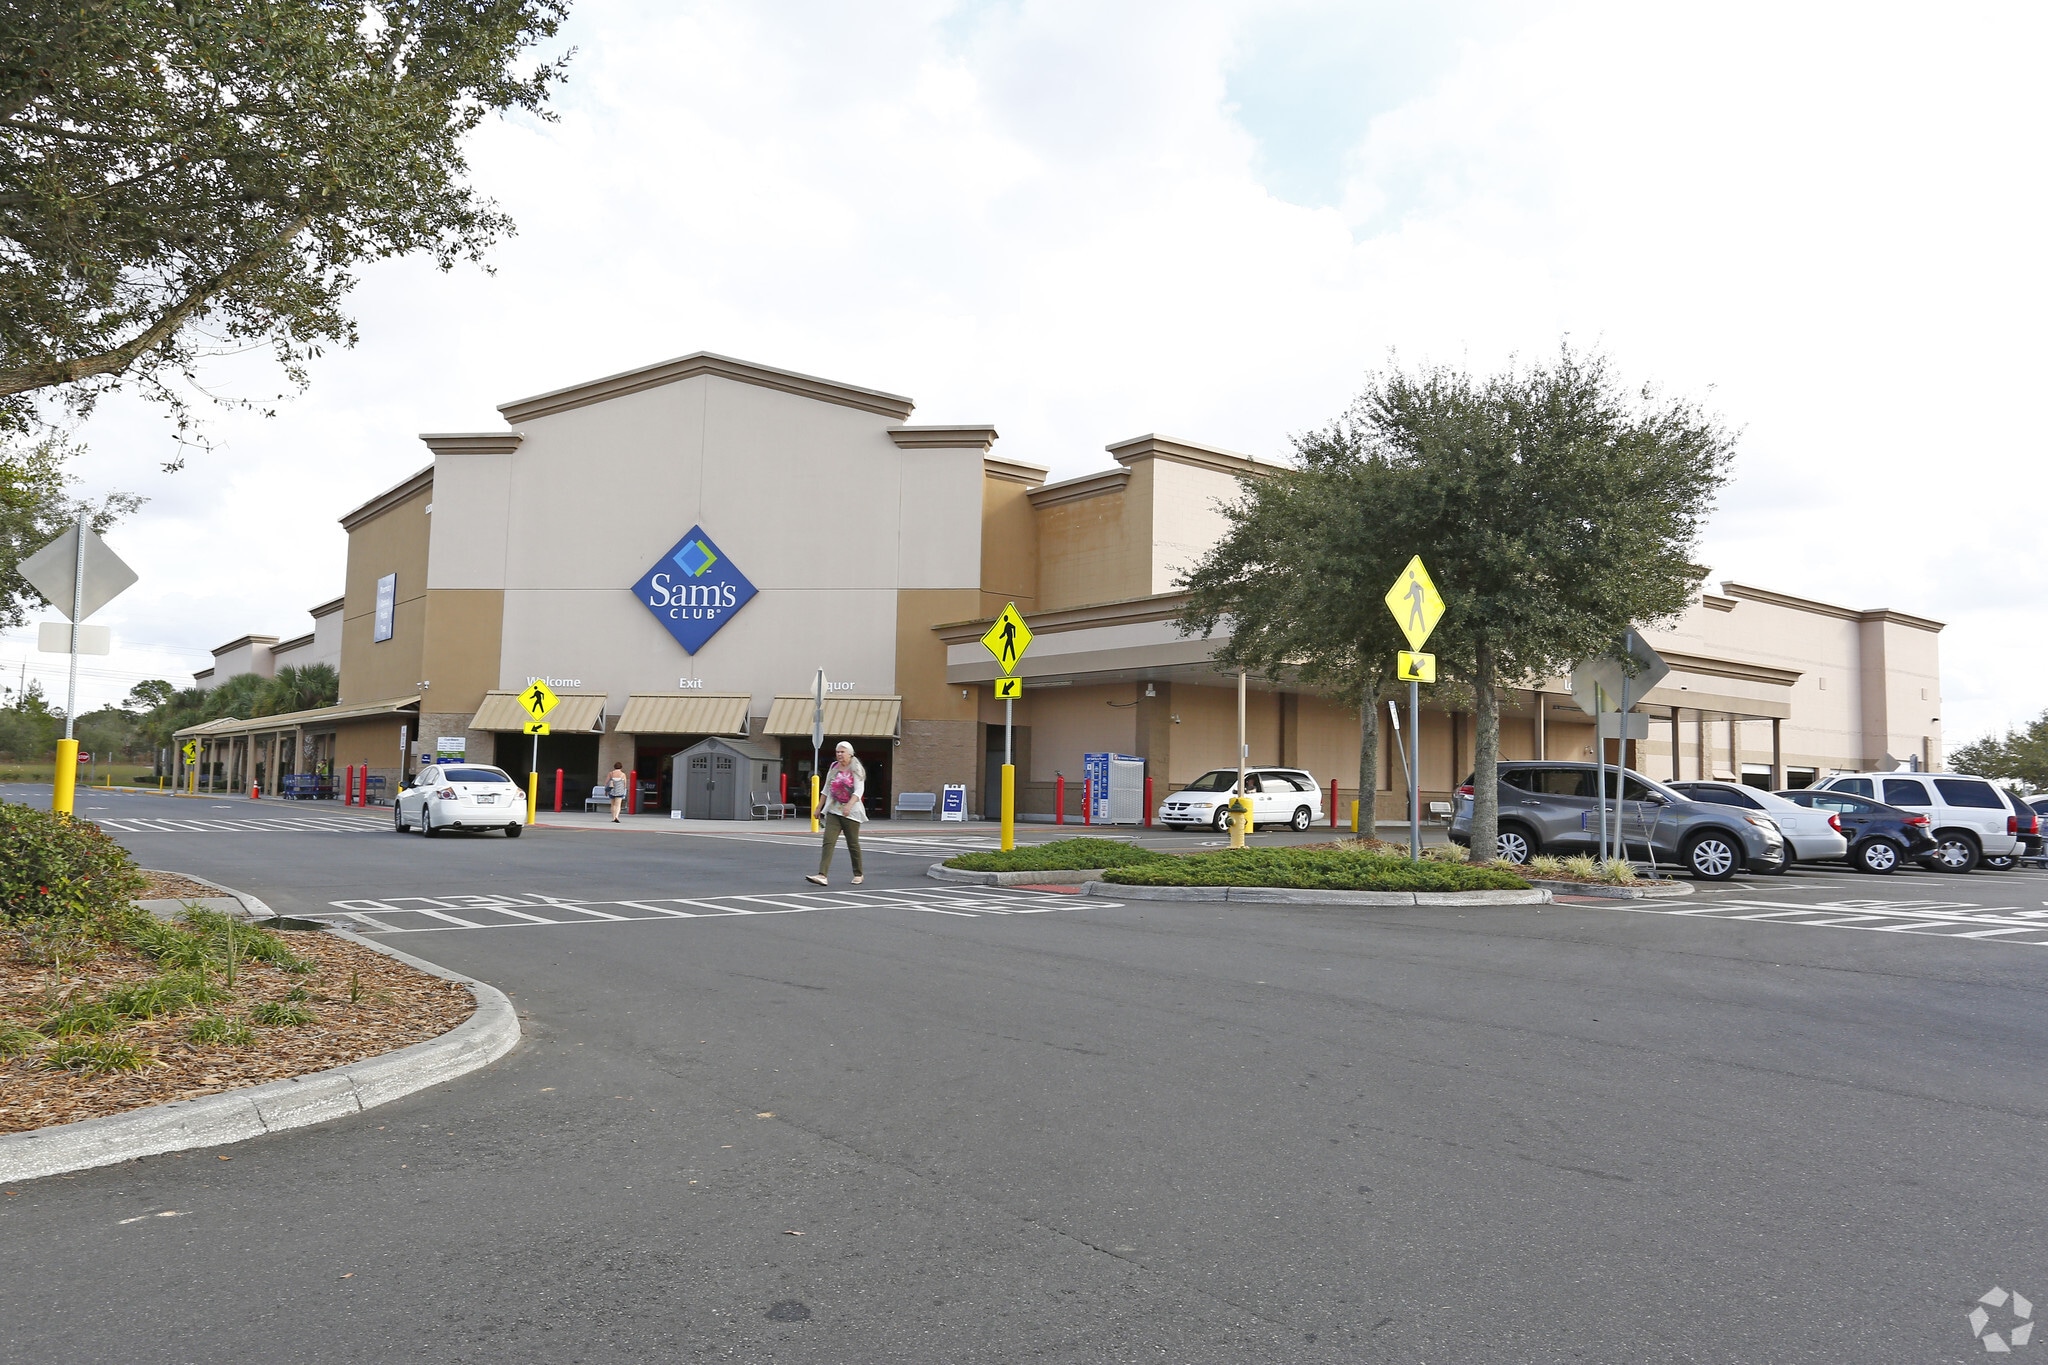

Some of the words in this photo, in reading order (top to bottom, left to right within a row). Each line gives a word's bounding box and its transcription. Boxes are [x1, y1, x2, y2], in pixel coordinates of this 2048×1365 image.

[649, 573, 736, 608] Sam's
[526, 676, 582, 687] Wlcome
[679, 677, 703, 689] Exit
[827, 681, 856, 693] quor
[327, 893, 590, 911] YIELD
[884, 898, 1126, 918] YIELD
